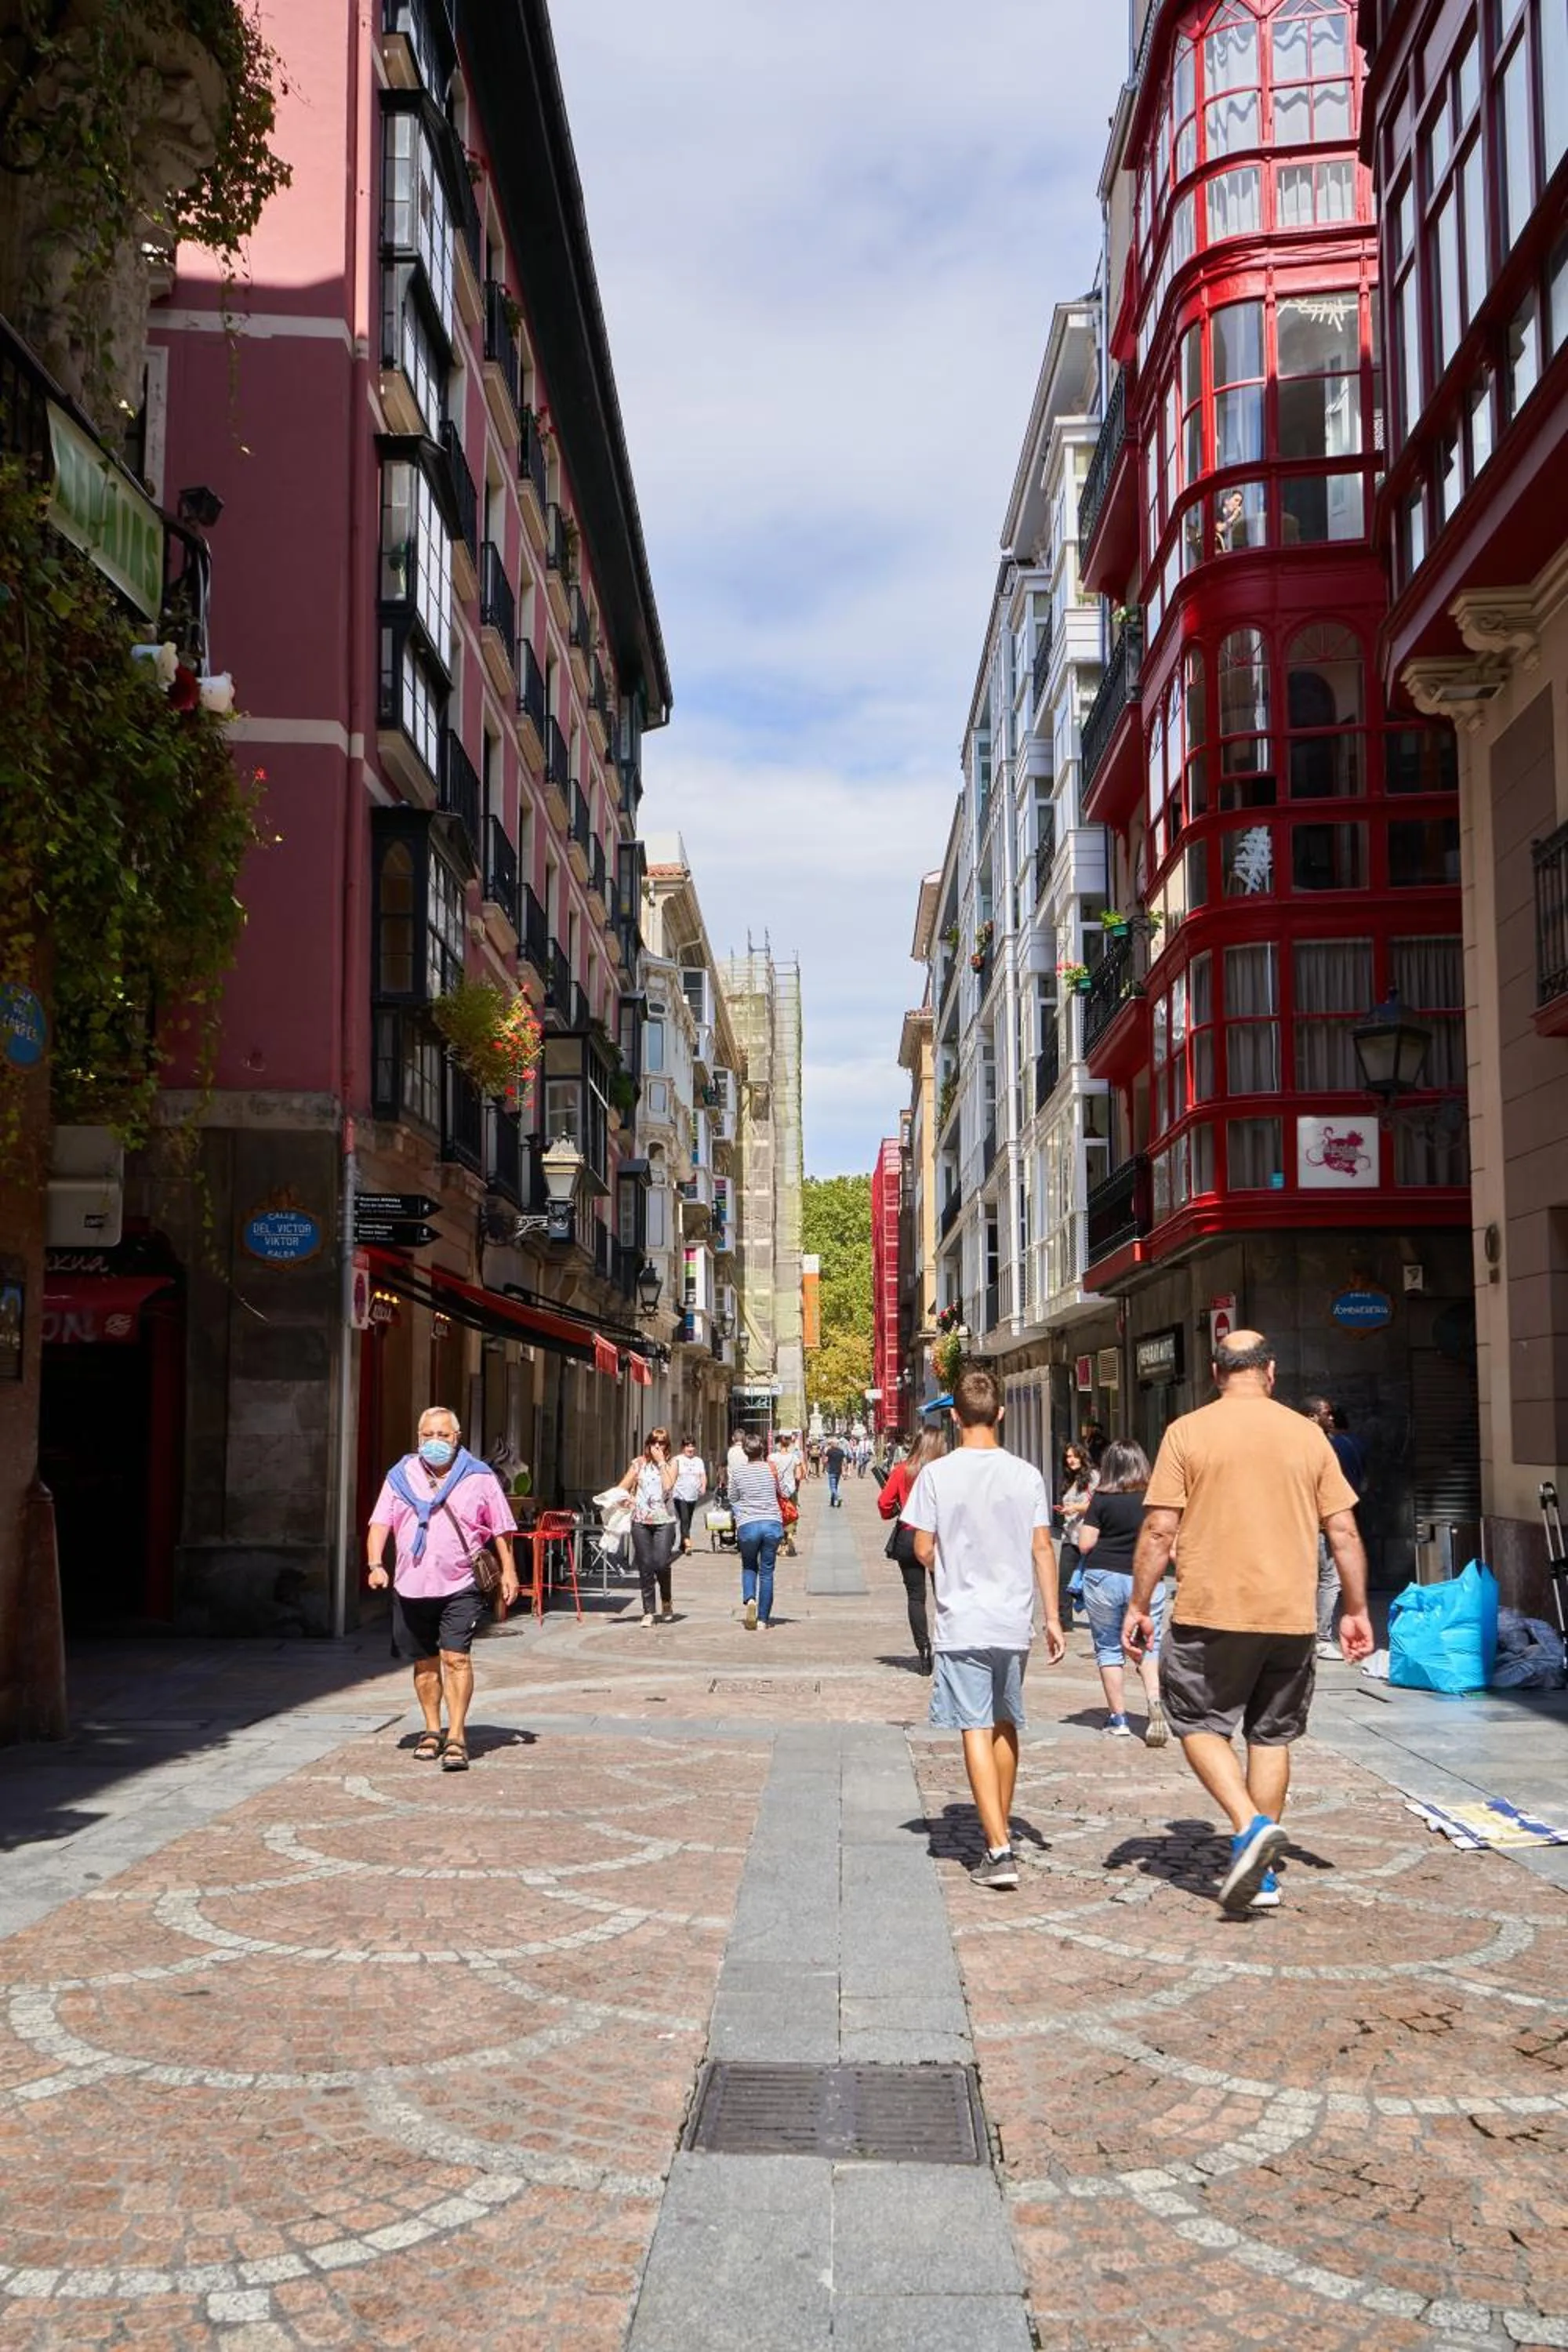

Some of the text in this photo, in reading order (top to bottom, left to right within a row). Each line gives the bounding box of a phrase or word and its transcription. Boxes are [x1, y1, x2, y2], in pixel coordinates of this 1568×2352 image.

[252, 1223, 312, 1233] DEL VICTOR
[264, 1236, 299, 1246] VIKTOR
